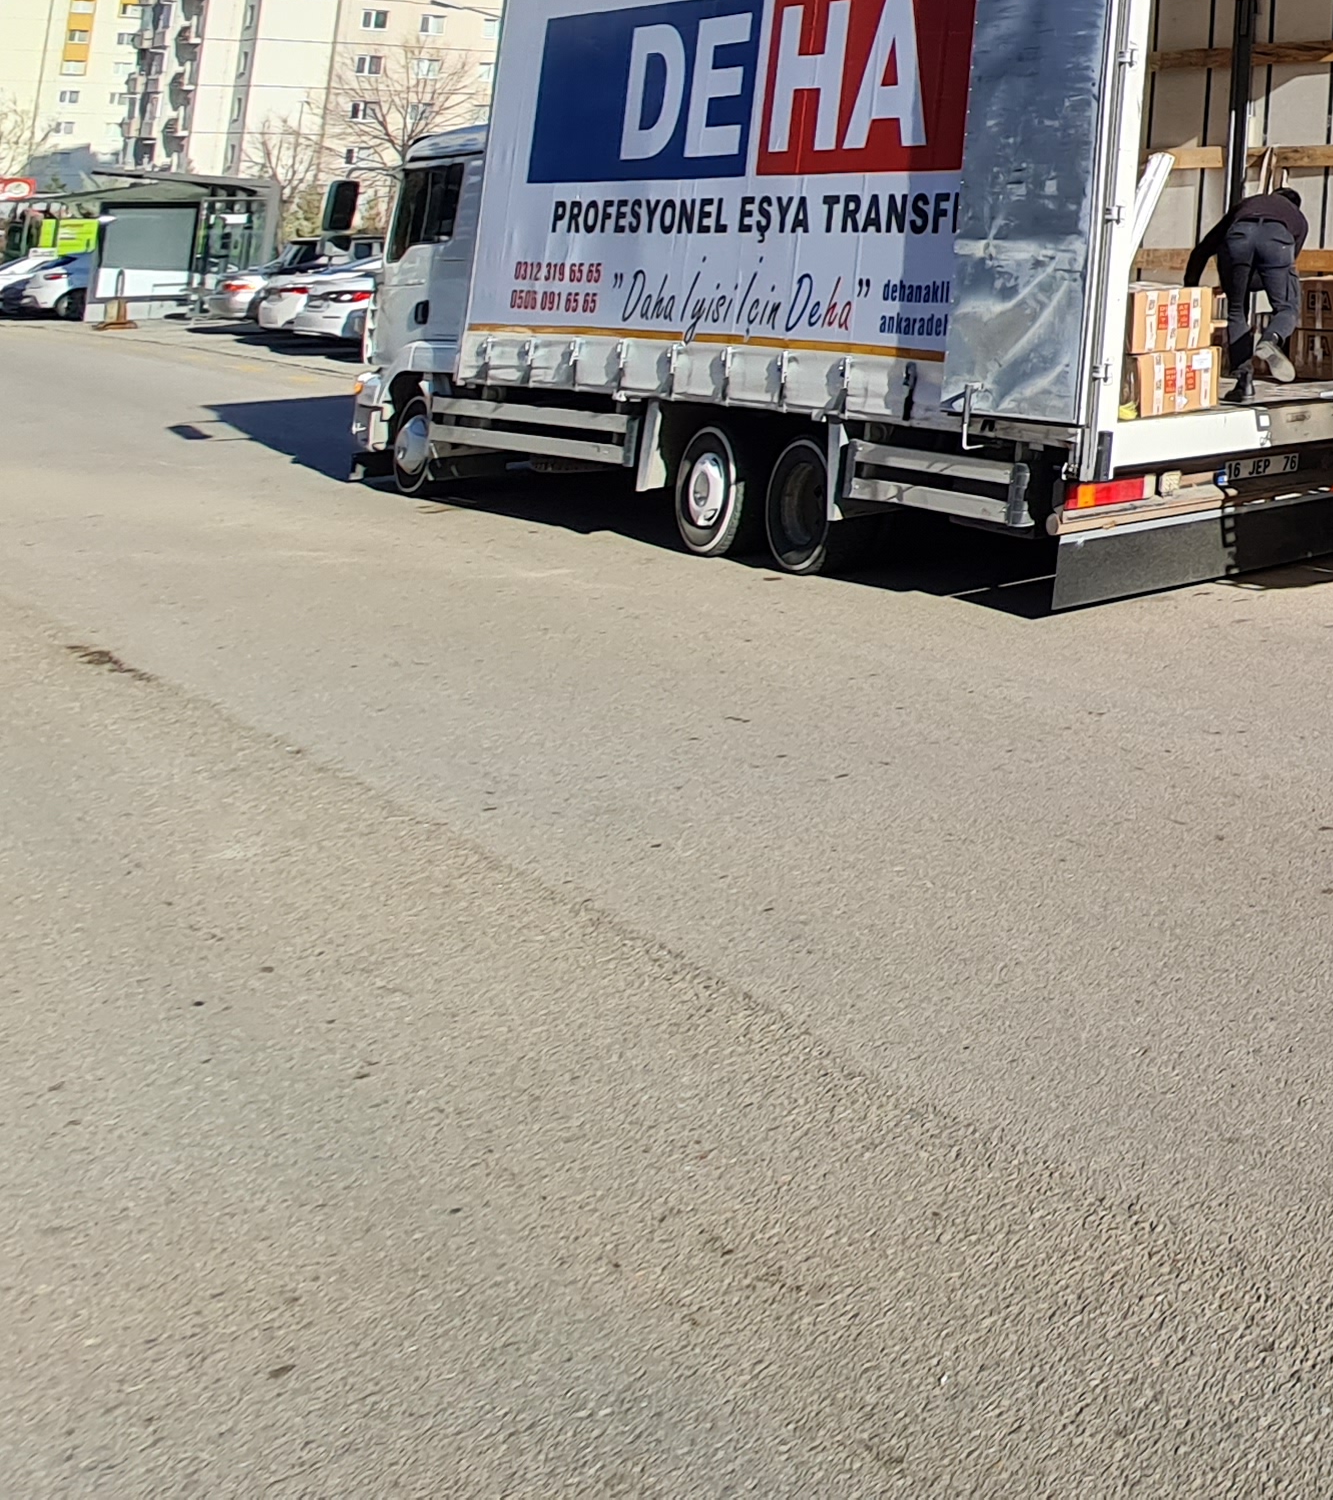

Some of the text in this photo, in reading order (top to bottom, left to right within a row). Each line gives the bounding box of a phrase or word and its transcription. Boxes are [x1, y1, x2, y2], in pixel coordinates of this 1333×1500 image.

[551, 197, 728, 234] PROFESYONEL
[737, 195, 810, 243] EŞYA
[514, 261, 602, 284] 0312 319 65 65
[510, 289, 598, 314] 0506 091 65 65
[1228, 454, 1297, 479] 16 JEP 76
